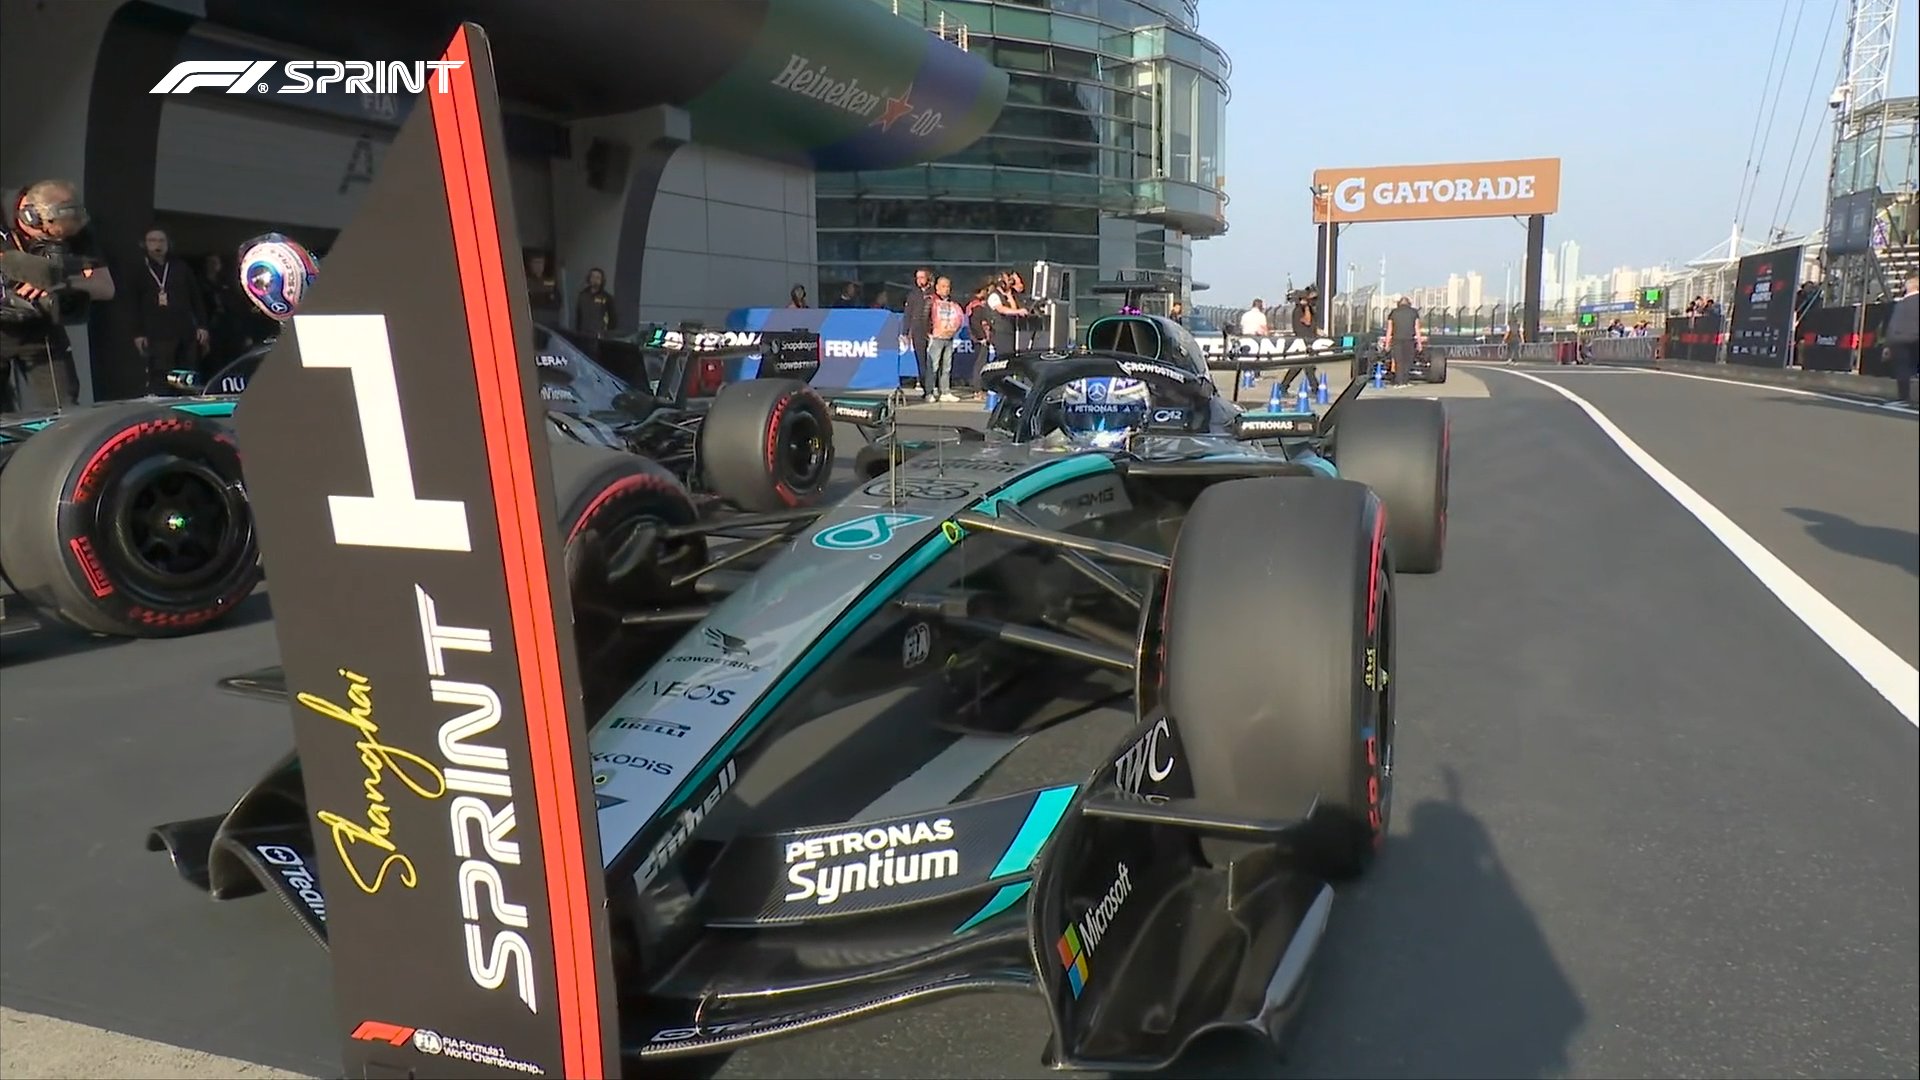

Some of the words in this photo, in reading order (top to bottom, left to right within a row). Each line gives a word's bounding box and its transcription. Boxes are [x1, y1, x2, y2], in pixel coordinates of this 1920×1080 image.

[771, 54, 880, 116] Heineken
[1334, 177, 1366, 212] G
[1373, 175, 1536, 205] GATORADE
[825, 336, 878, 358] FERMÉ
[1075, 404, 1118, 413] PETRONAS
[1242, 420, 1294, 431] PETRONAS
[293, 314, 471, 551] 1
[666, 656, 761, 673] CROWDSTRIKE
[609, 716, 692, 738] PIRELLI
[1114, 716, 1175, 794] IWC
[297, 667, 447, 894] Shanghai
[414, 583, 537, 1015] SPRINT
[785, 818, 955, 863] PETRONAS
[785, 848, 959, 905] Syntium
[1078, 861, 1134, 958] Microsoft
[443, 1036, 459, 1049] FIA
[459, 1039, 499, 1057] Formula
[444, 1047, 473, 1062] World
